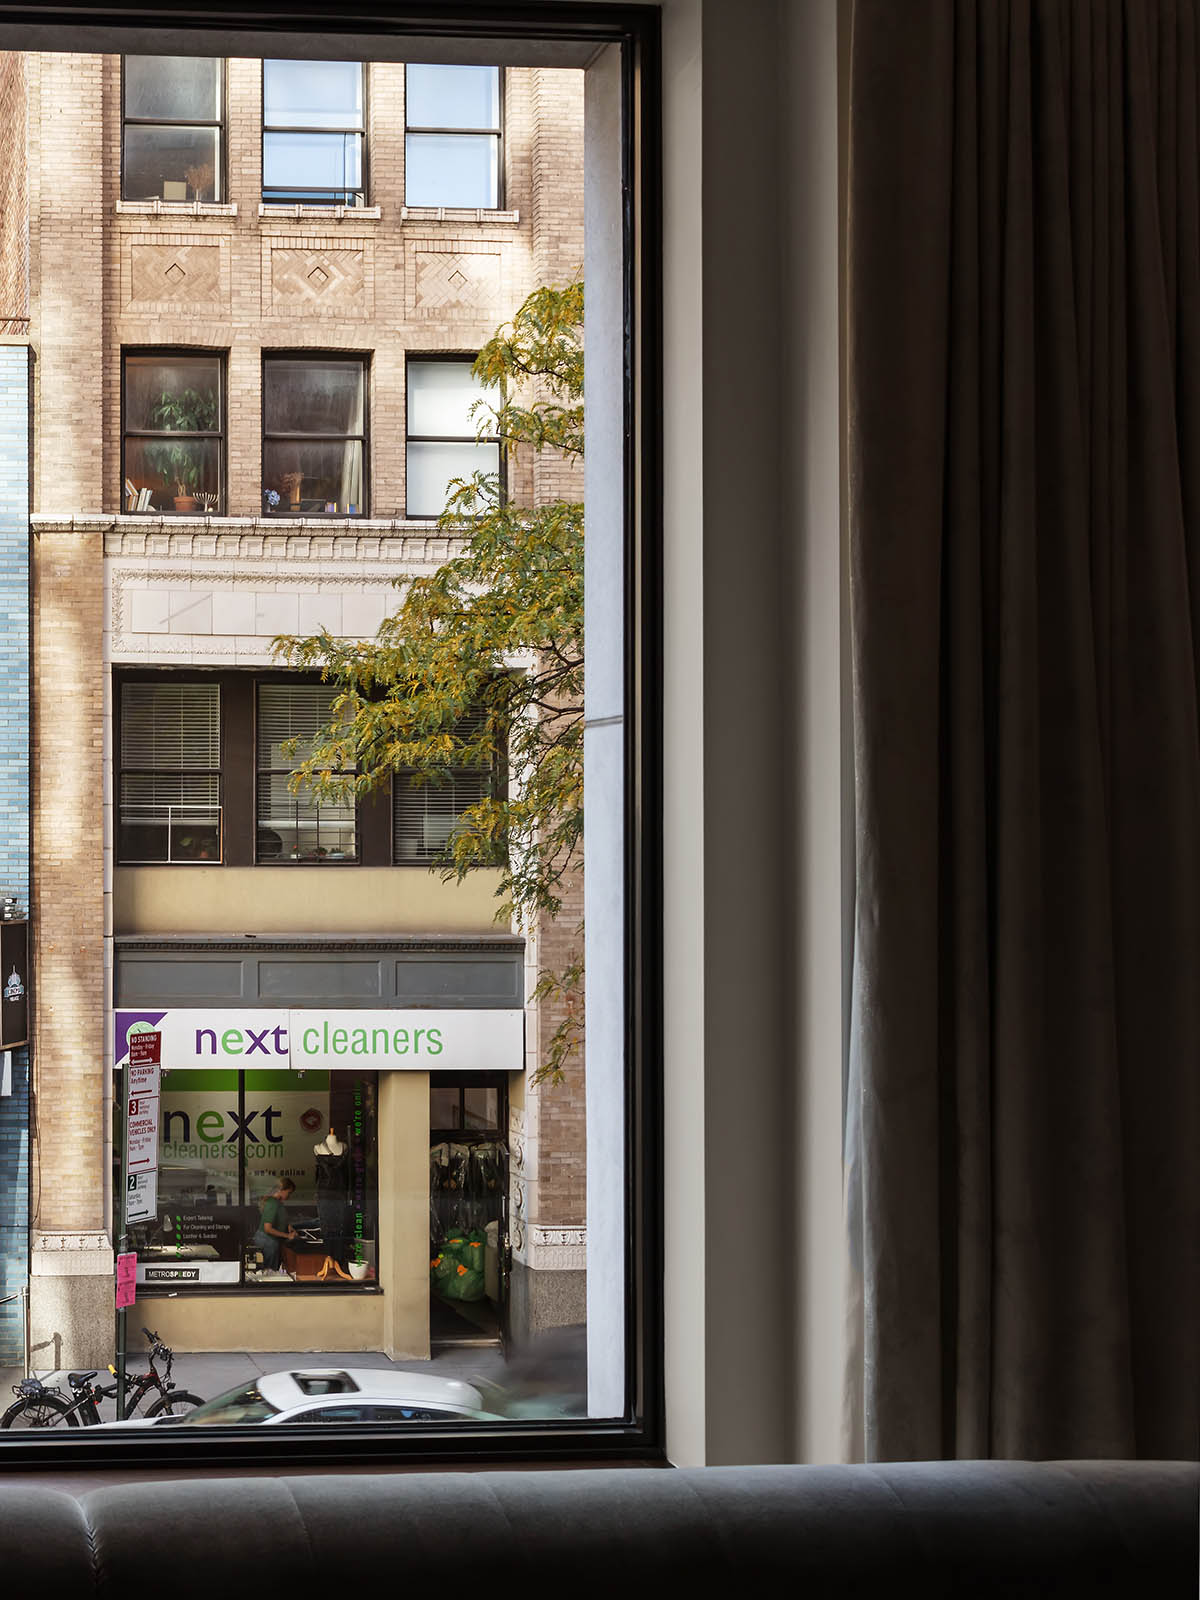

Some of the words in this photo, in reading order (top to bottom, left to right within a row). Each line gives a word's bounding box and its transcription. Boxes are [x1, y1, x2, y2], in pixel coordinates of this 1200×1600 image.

[138, 1034, 157, 1043] STANDING
[195, 1025, 289, 1055] next
[303, 1021, 443, 1055] cleaners
[131, 1101, 136, 1114] 3
[129, 1119, 152, 1128] COMMERCIAL
[163, 1105, 283, 1143] next
[129, 1127, 146, 1136] VEHICLES
[129, 1176, 135, 1189] 2
[354, 1212, 362, 1239] clean
